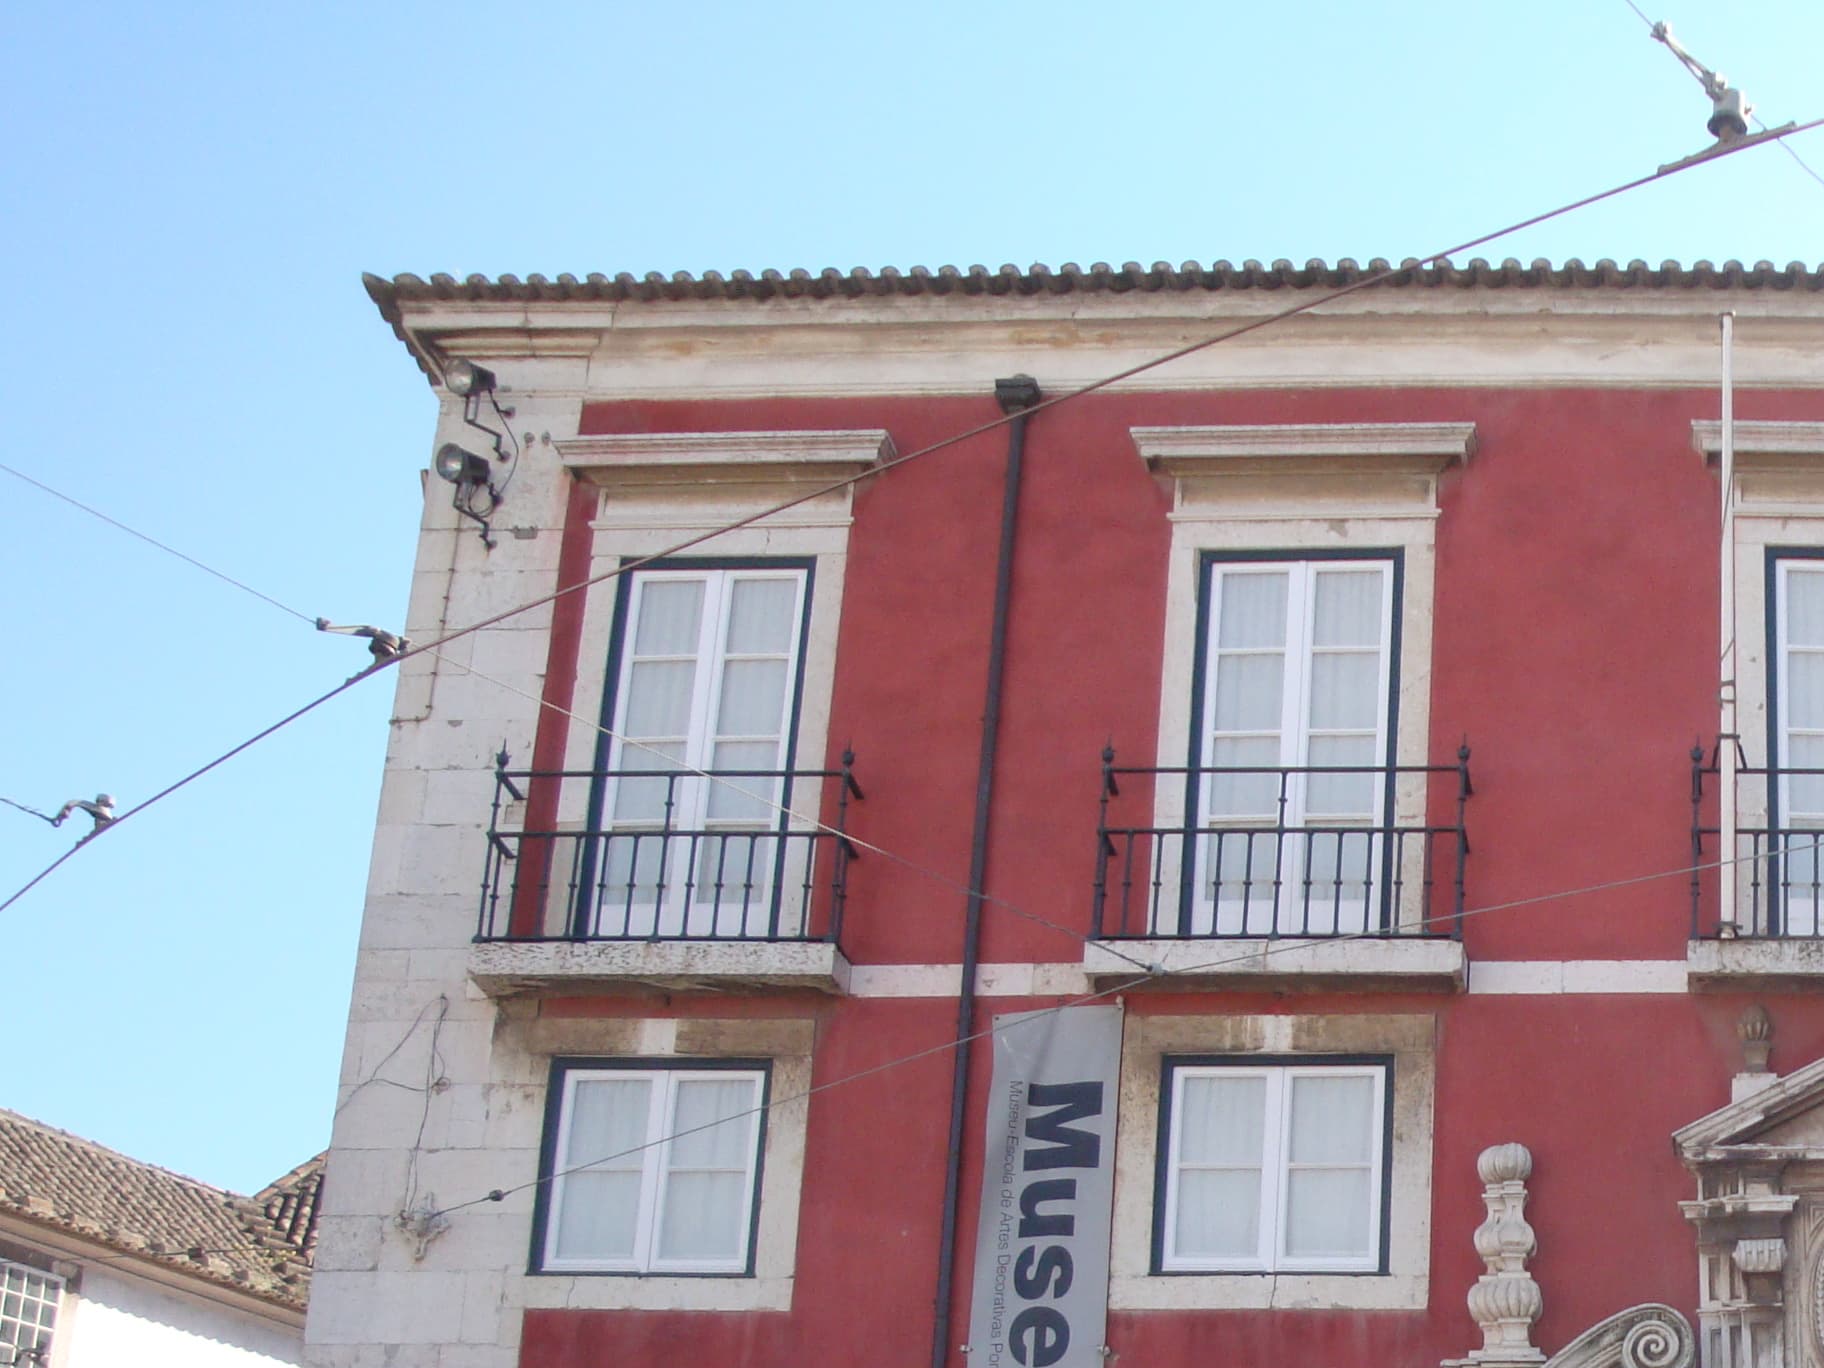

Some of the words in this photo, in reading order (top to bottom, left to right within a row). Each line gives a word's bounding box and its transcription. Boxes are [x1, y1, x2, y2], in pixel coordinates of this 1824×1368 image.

[1000, 1190, 1015, 1209] de
[997, 1212, 1014, 1249] Artes
[991, 1254, 1011, 1338] Decorativas
